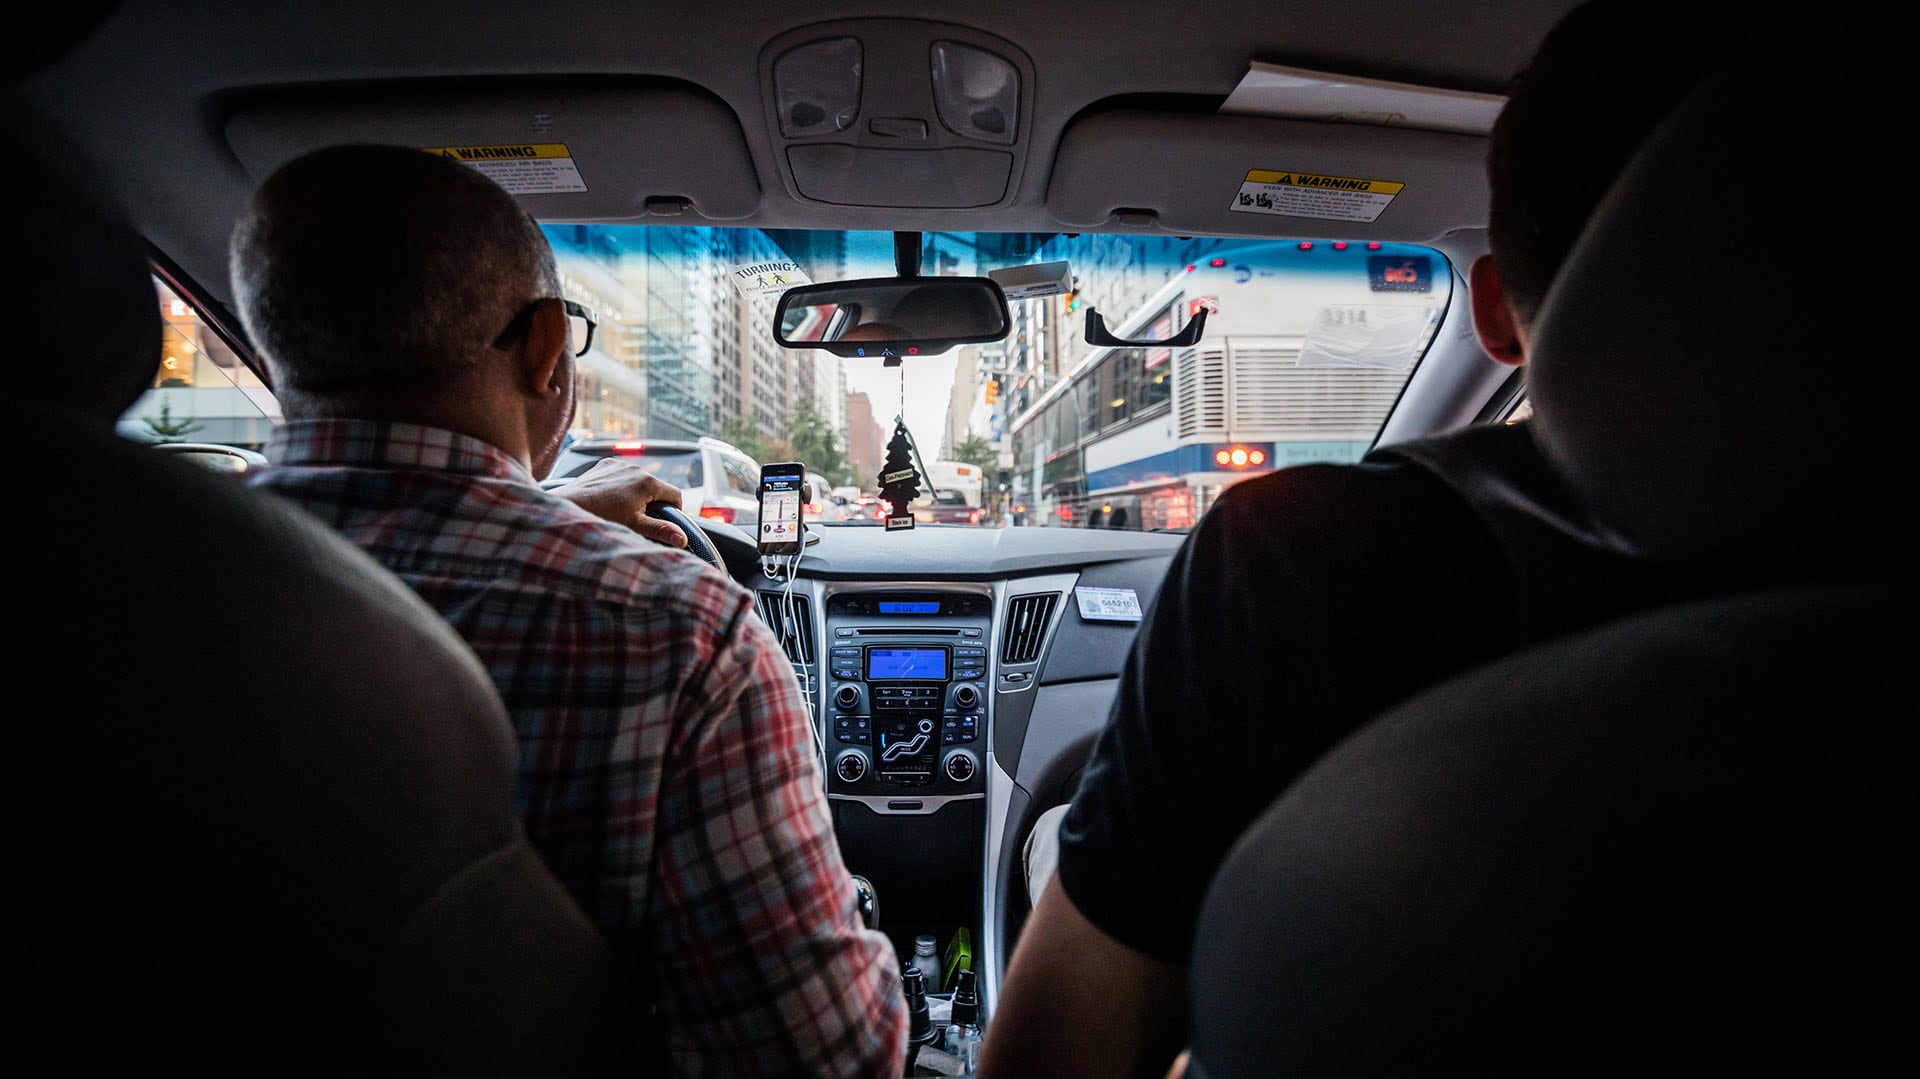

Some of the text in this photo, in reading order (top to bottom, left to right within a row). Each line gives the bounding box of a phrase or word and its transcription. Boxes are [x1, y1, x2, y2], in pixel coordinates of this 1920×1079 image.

[456, 147, 537, 159] WARNING
[1297, 176, 1371, 190] WARNING
[1303, 188, 1339, 196] ADVANCED
[736, 263, 799, 279] TURNING?
